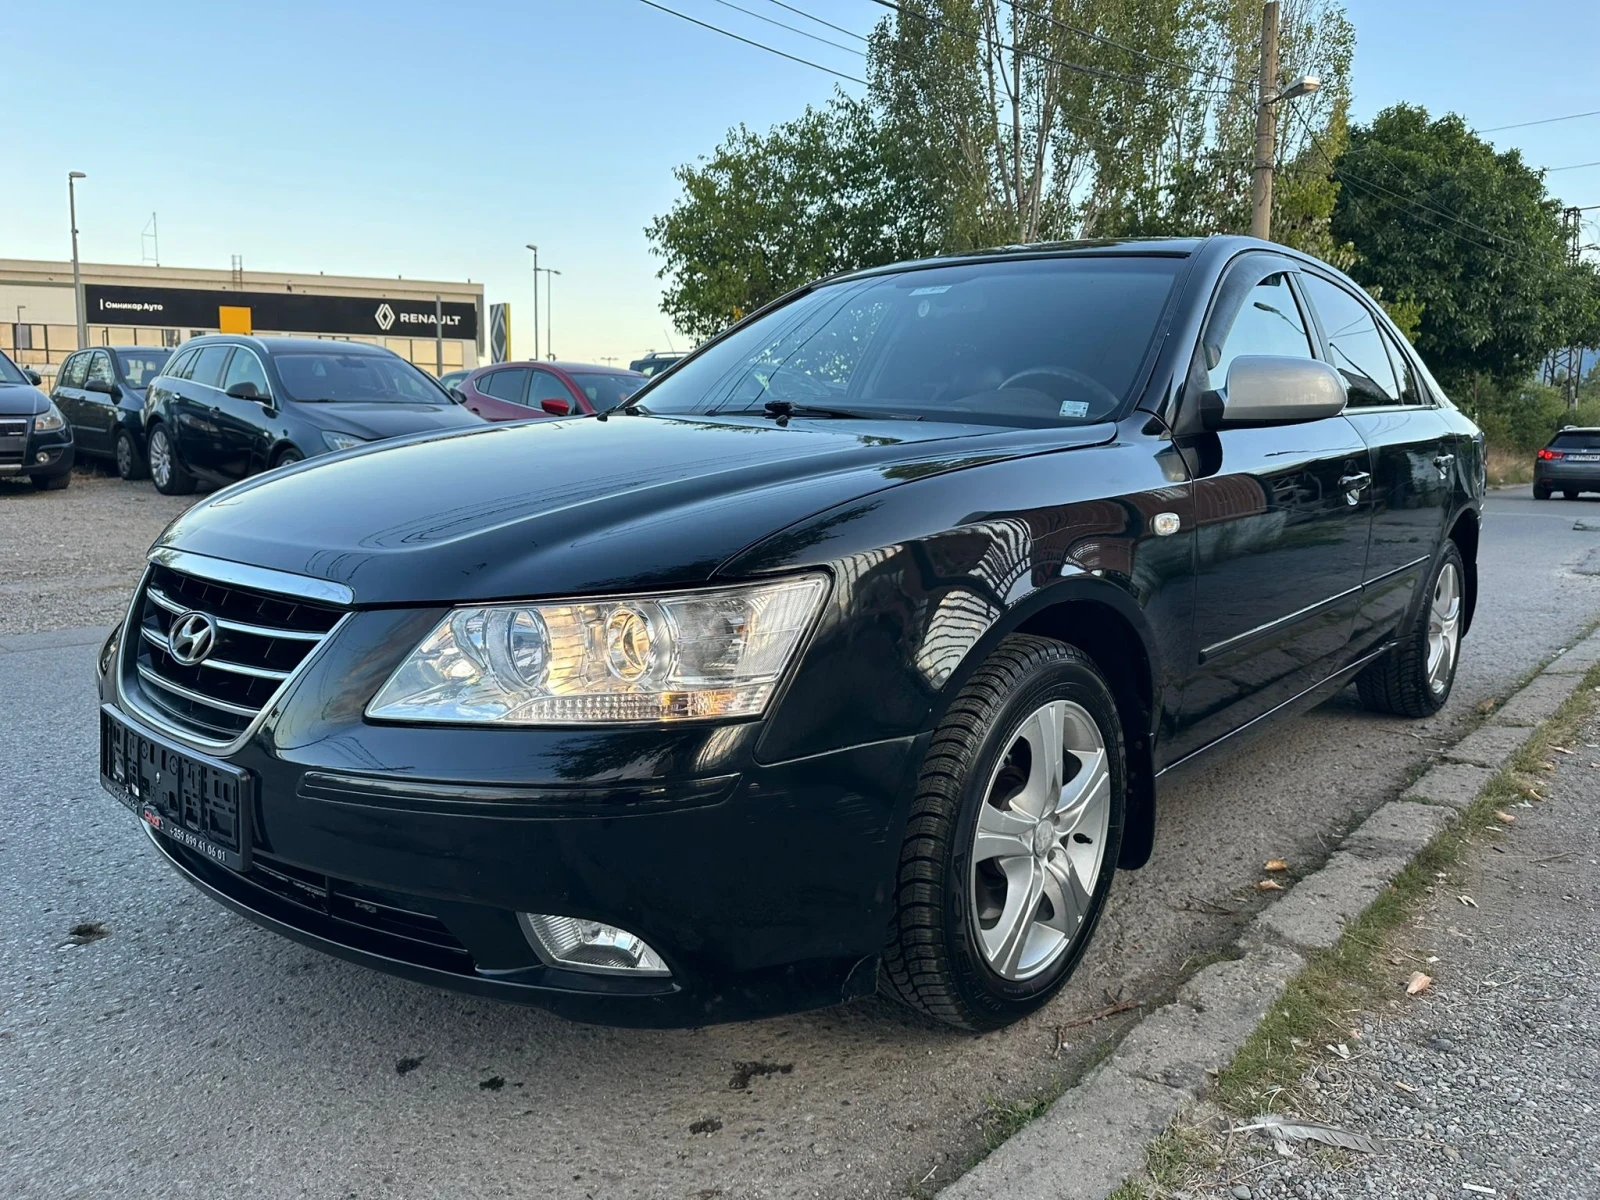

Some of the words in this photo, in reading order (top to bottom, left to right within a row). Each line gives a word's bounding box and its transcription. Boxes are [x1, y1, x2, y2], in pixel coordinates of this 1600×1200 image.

[105, 301, 142, 311] Омникар
[143, 303, 163, 311] Ауто
[400, 313, 461, 325] RENAULT
[185, 834, 197, 848] 899
[198, 841, 206, 852] 41
[207, 846, 216, 857] 06
[217, 849, 226, 862] 01
